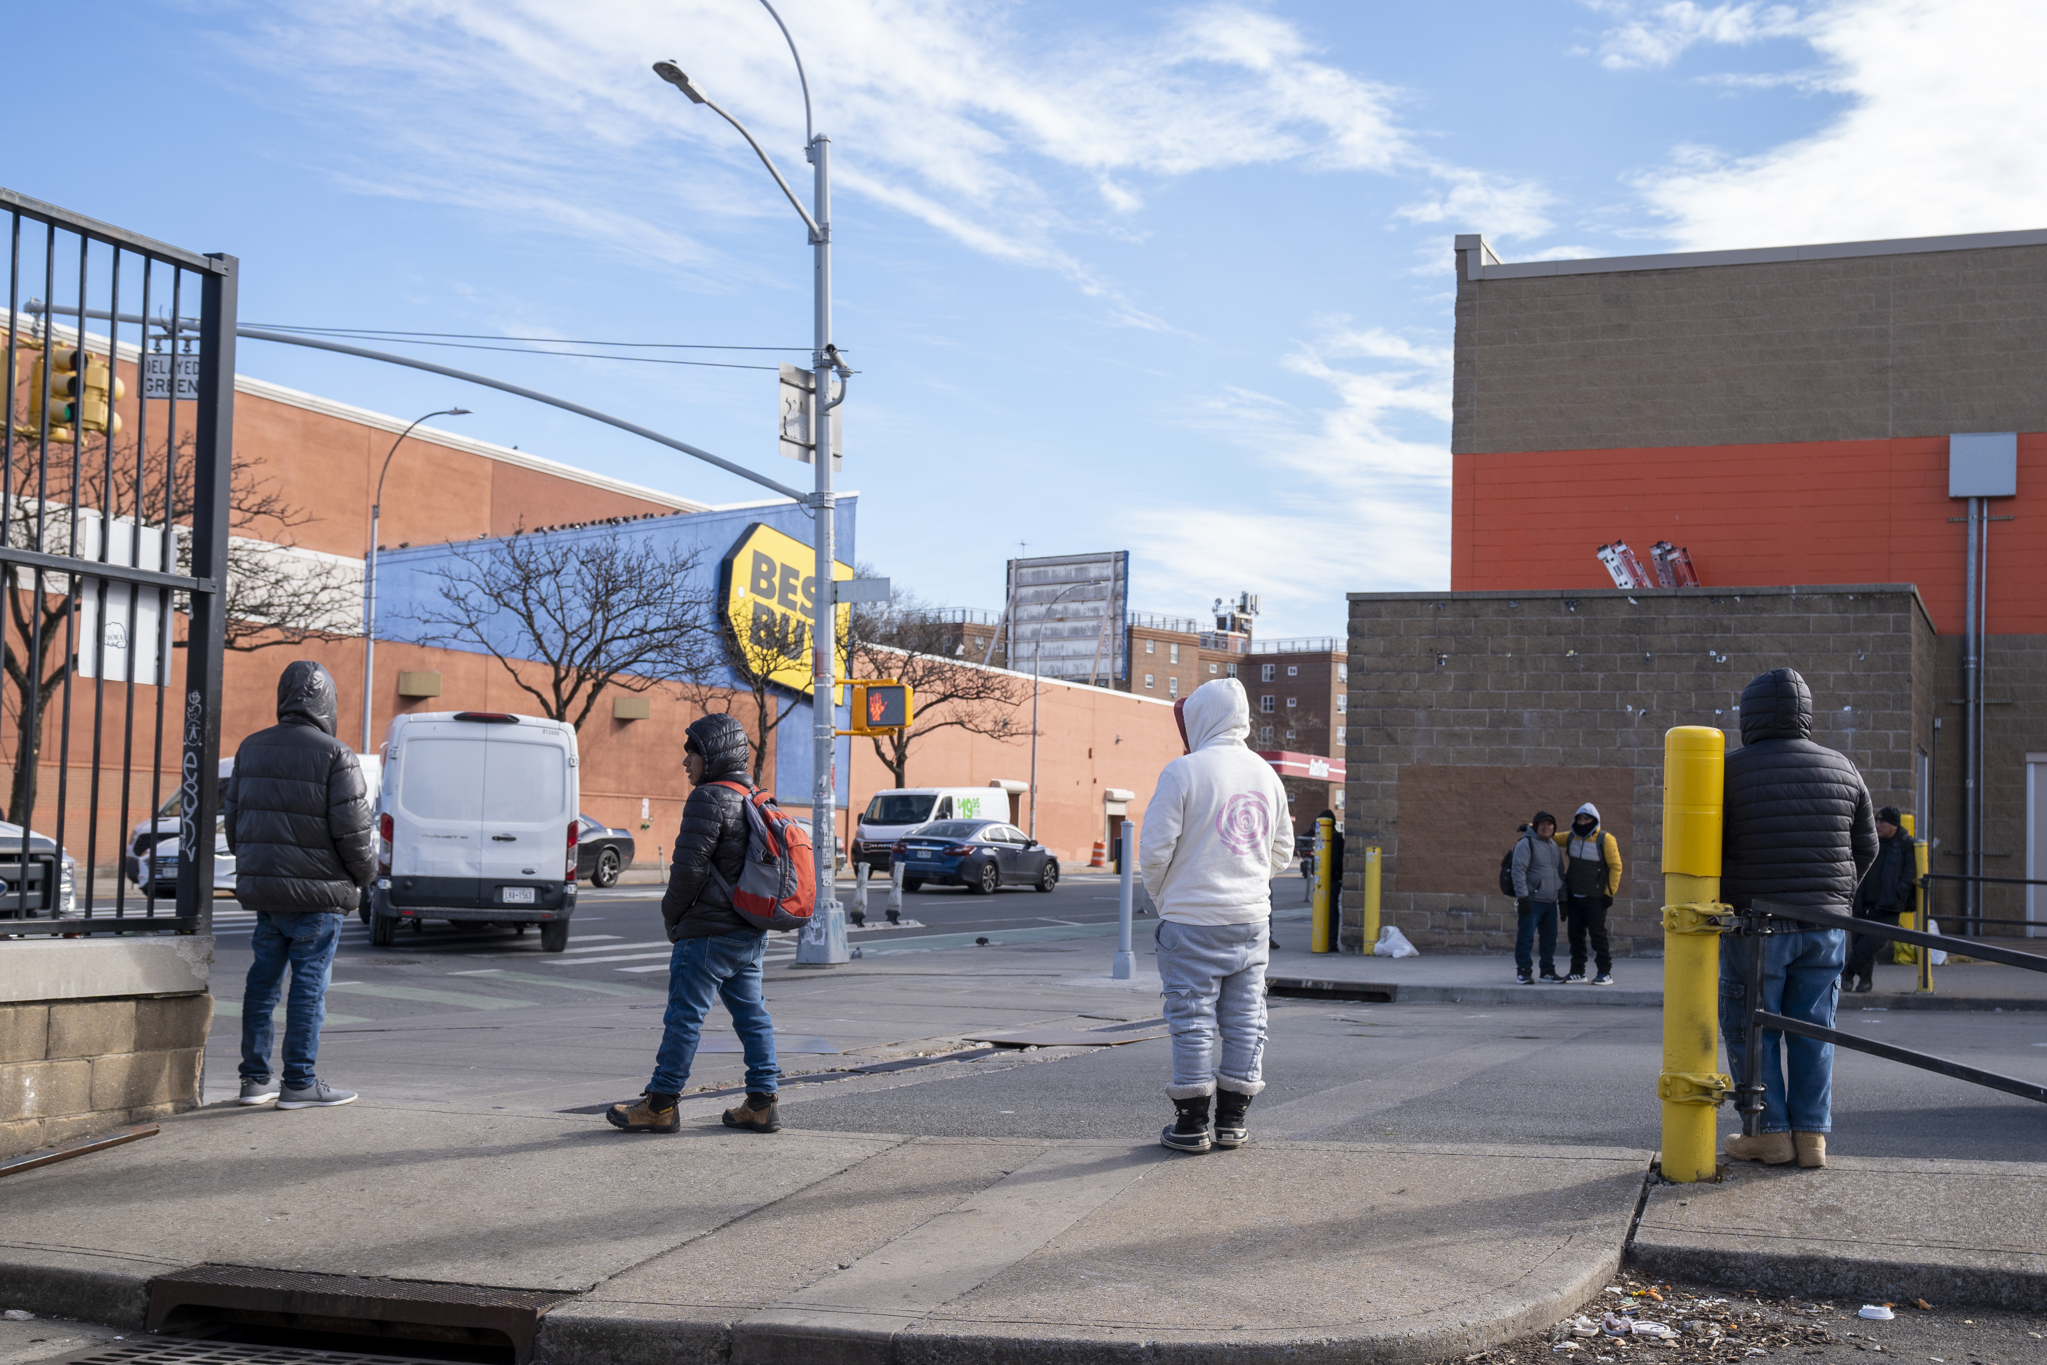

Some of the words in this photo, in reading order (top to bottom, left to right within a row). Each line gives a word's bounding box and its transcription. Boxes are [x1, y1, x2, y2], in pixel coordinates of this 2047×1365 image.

[146, 360, 199, 375] DELYED
[750, 549, 815, 620] BES
[749, 600, 814, 661] BU
